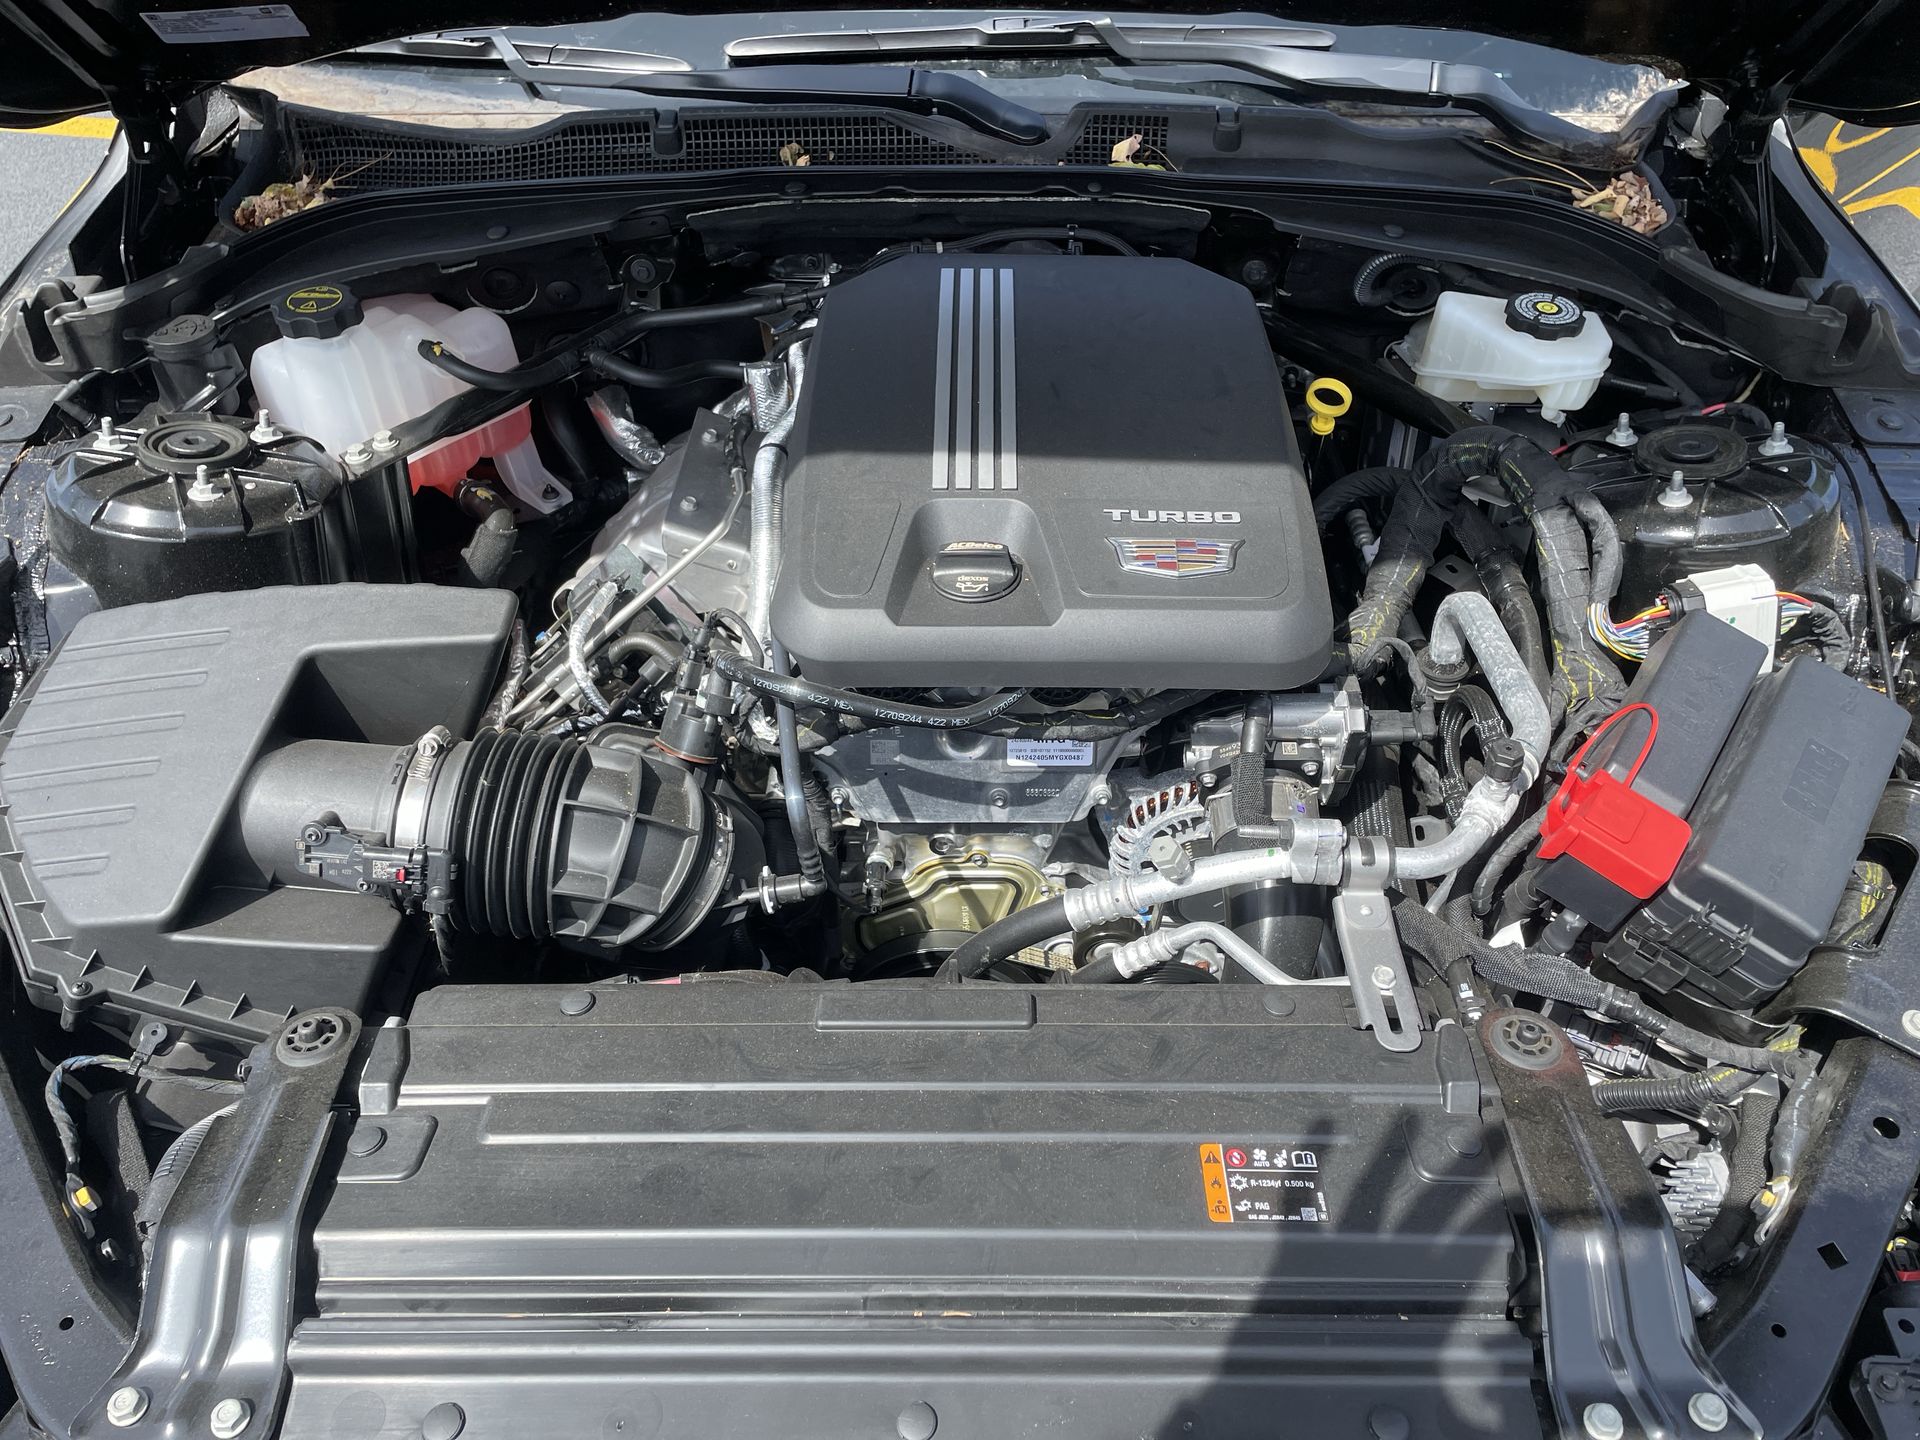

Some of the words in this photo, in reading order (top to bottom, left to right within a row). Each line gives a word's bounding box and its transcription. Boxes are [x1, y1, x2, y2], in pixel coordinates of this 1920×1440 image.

[1103, 508, 1241, 523] TURBO
[944, 542, 1003, 551] ACDelco
[807, 693, 829, 705] 422
[833, 699, 854, 711] MEX
[874, 708, 922, 724] 12709244
[928, 717, 946, 727] 422
[952, 718, 970, 726] MEX
[1250, 1179, 1281, 1189] R-1234yf
[1284, 1179, 1304, 1187] 0.500
[1305, 1181, 1314, 1189] kg
[1254, 1202, 1270, 1210] PAG
